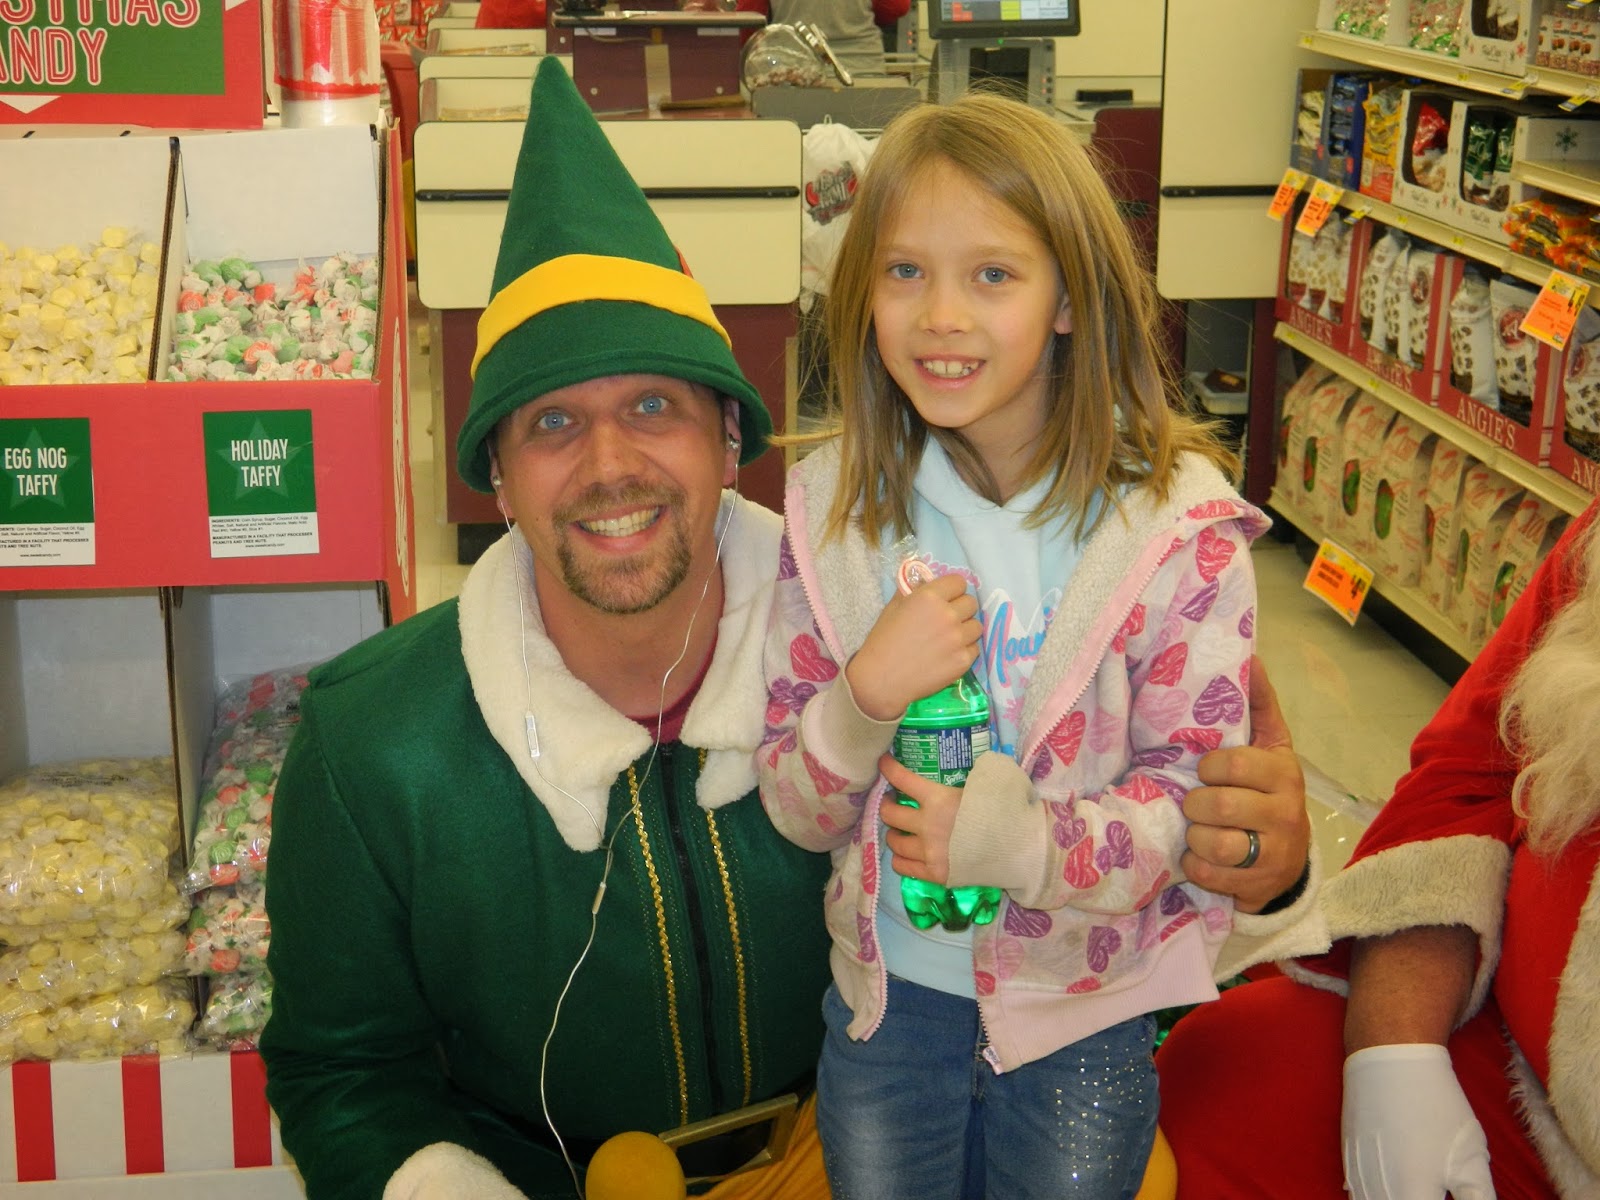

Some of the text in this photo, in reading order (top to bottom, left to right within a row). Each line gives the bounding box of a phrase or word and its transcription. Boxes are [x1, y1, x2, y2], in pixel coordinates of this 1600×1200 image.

[1456, 397, 1516, 450] ANGIE'S
[4, 447, 67, 470] EGG NOG
[231, 438, 288, 461] HOLIDAY
[16, 474, 58, 496] TAFFY
[241, 465, 281, 487] TAFFY
